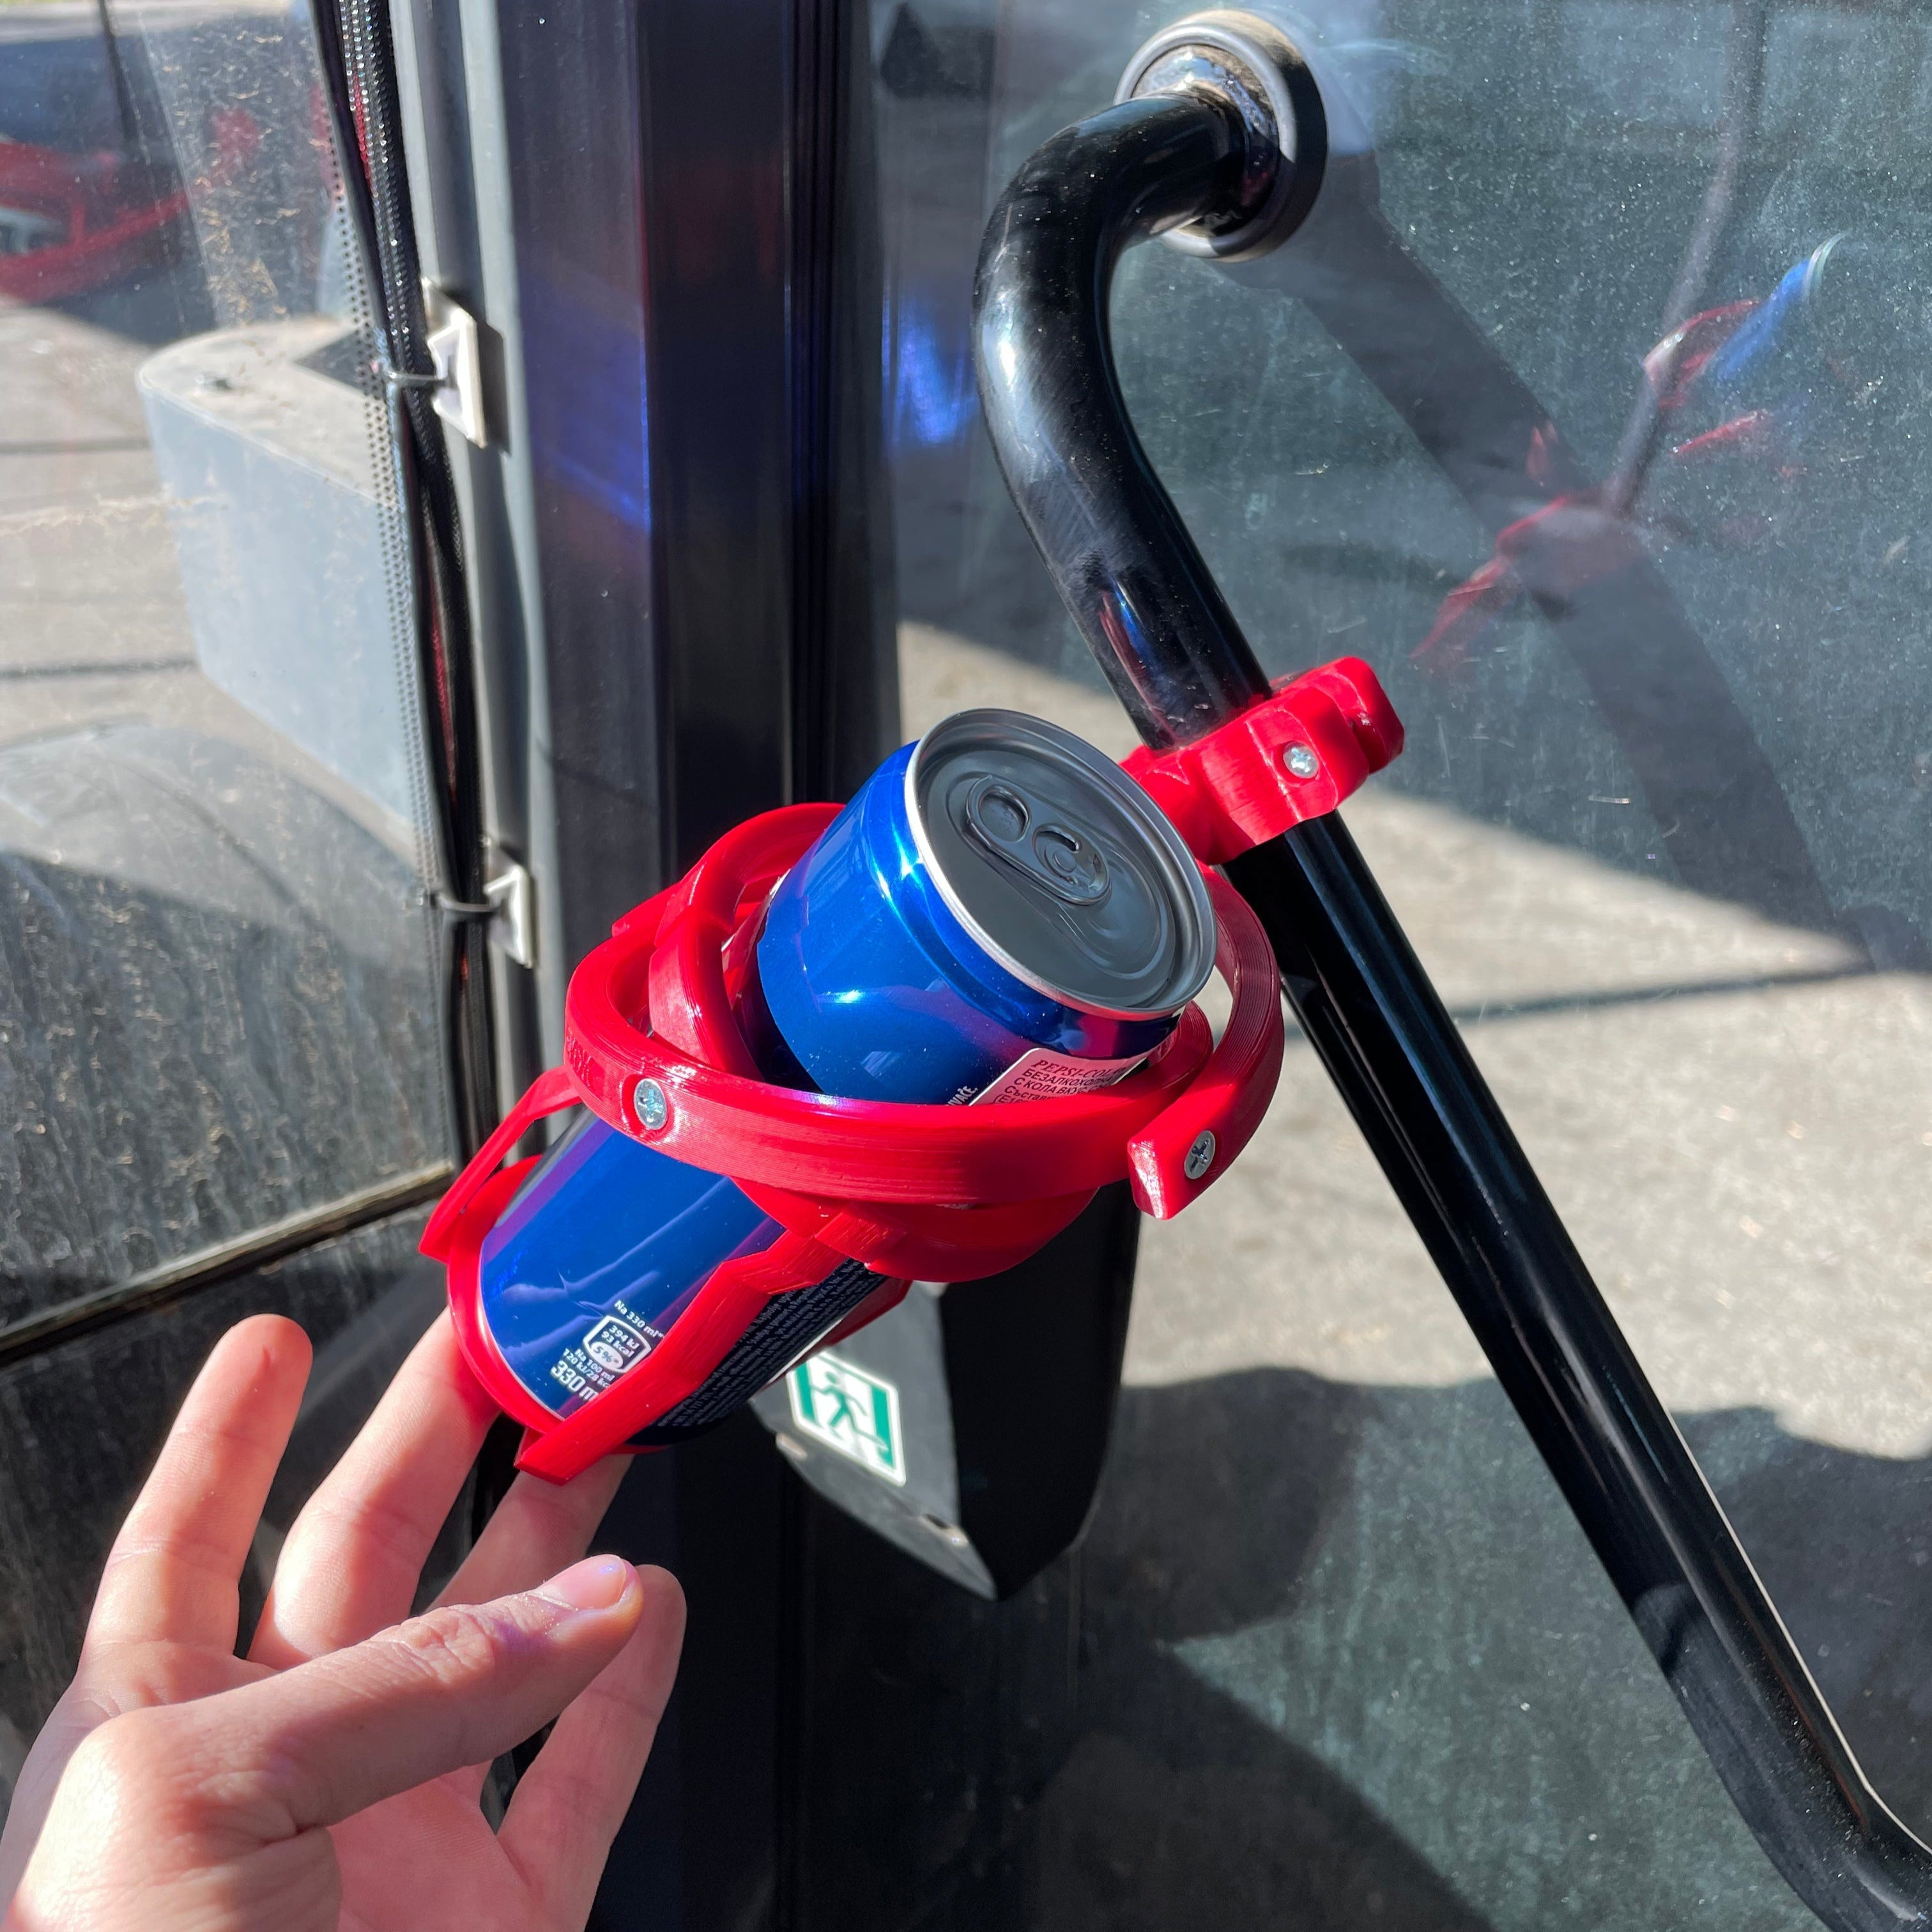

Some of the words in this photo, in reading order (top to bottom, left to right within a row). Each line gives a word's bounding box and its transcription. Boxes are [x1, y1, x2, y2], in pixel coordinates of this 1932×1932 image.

[614, 1300, 628, 1315] Na
[626, 1312, 645, 1328] 330
[601, 1331, 615, 1343] 93
[613, 1340, 634, 1358] kcal
[609, 1325, 629, 1342] 394
[563, 1348, 578, 1364] 120
[574, 1348, 587, 1362] Na
[586, 1359, 603, 1373] 100
[601, 1371, 615, 1381] ml
[551, 1360, 586, 1392] 330
[578, 1386, 599, 1401] m
